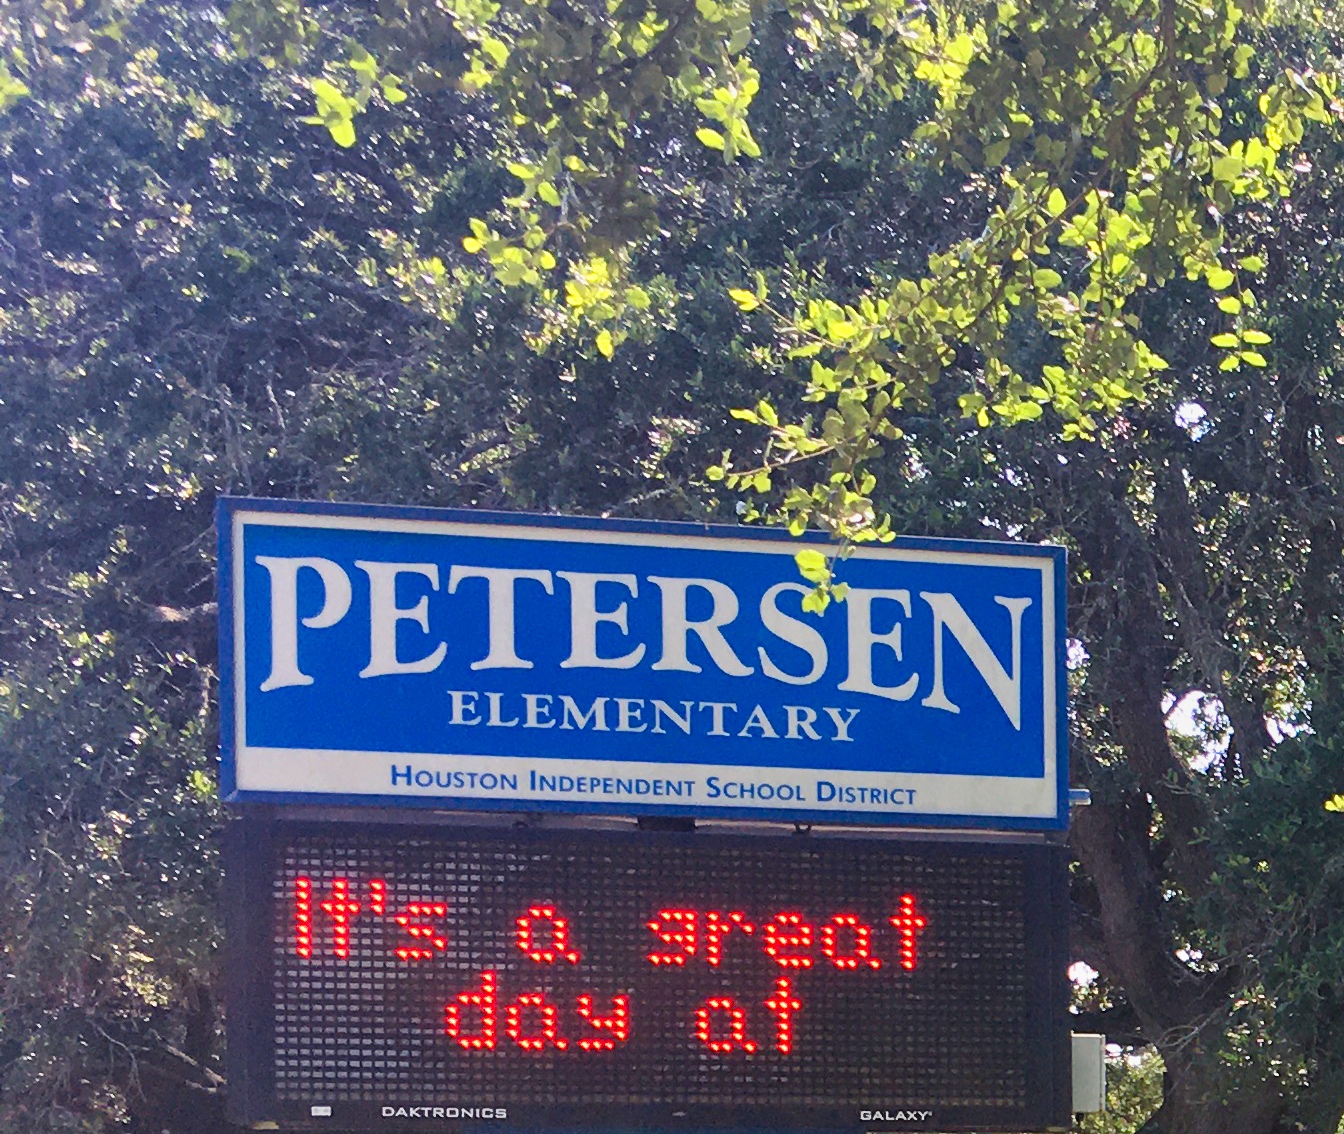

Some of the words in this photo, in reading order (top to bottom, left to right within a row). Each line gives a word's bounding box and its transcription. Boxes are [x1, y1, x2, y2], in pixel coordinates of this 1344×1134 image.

[256, 555, 1033, 730] PETERSEN
[448, 690, 861, 742] ELEMENTARY
[296, 878, 447, 959] It's
[515, 905, 581, 965] a
[646, 894, 927, 971] great
[445, 970, 630, 1052] day
[695, 977, 802, 1055] at
[381, 1106, 507, 1119] DAKTRONICS
